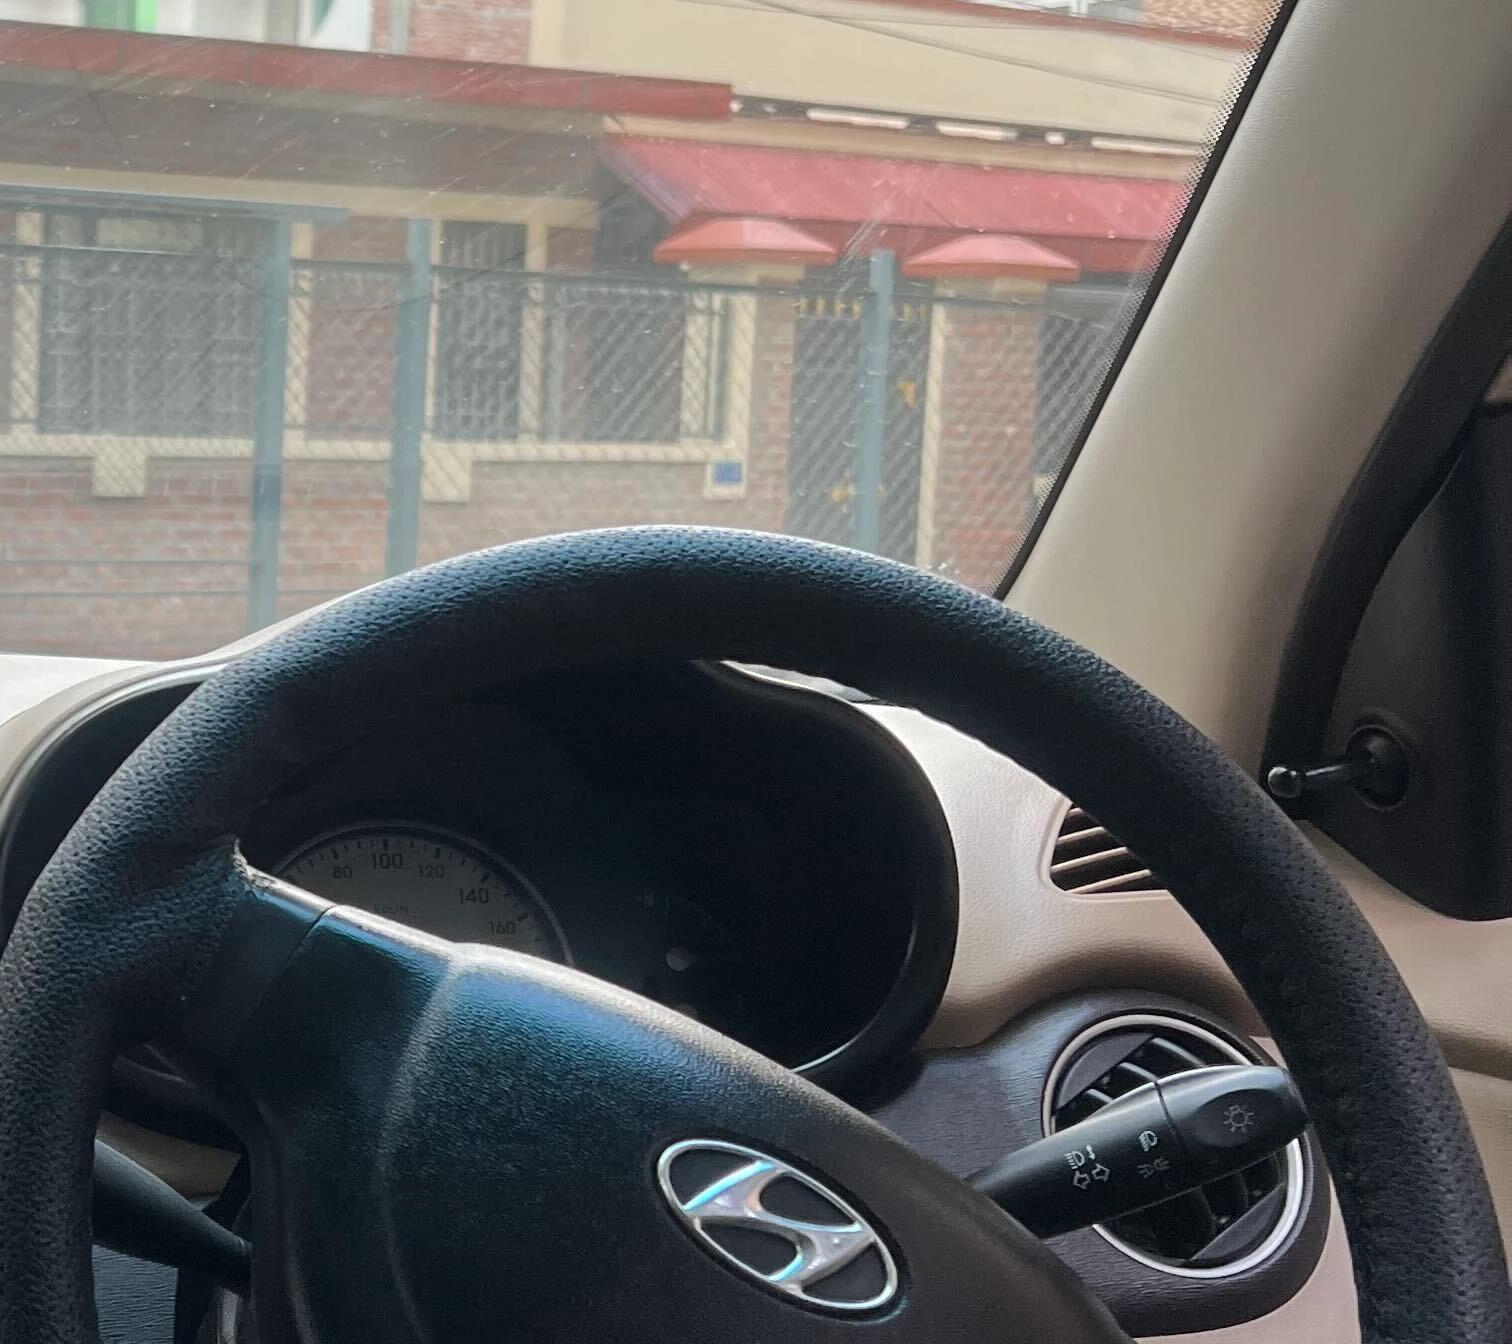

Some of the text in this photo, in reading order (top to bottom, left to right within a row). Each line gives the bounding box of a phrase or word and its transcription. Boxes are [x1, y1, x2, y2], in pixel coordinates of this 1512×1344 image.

[371, 853, 404, 870] 100
[417, 864, 446, 879] 120
[458, 887, 490, 905] 140
[489, 920, 516, 935] 160
